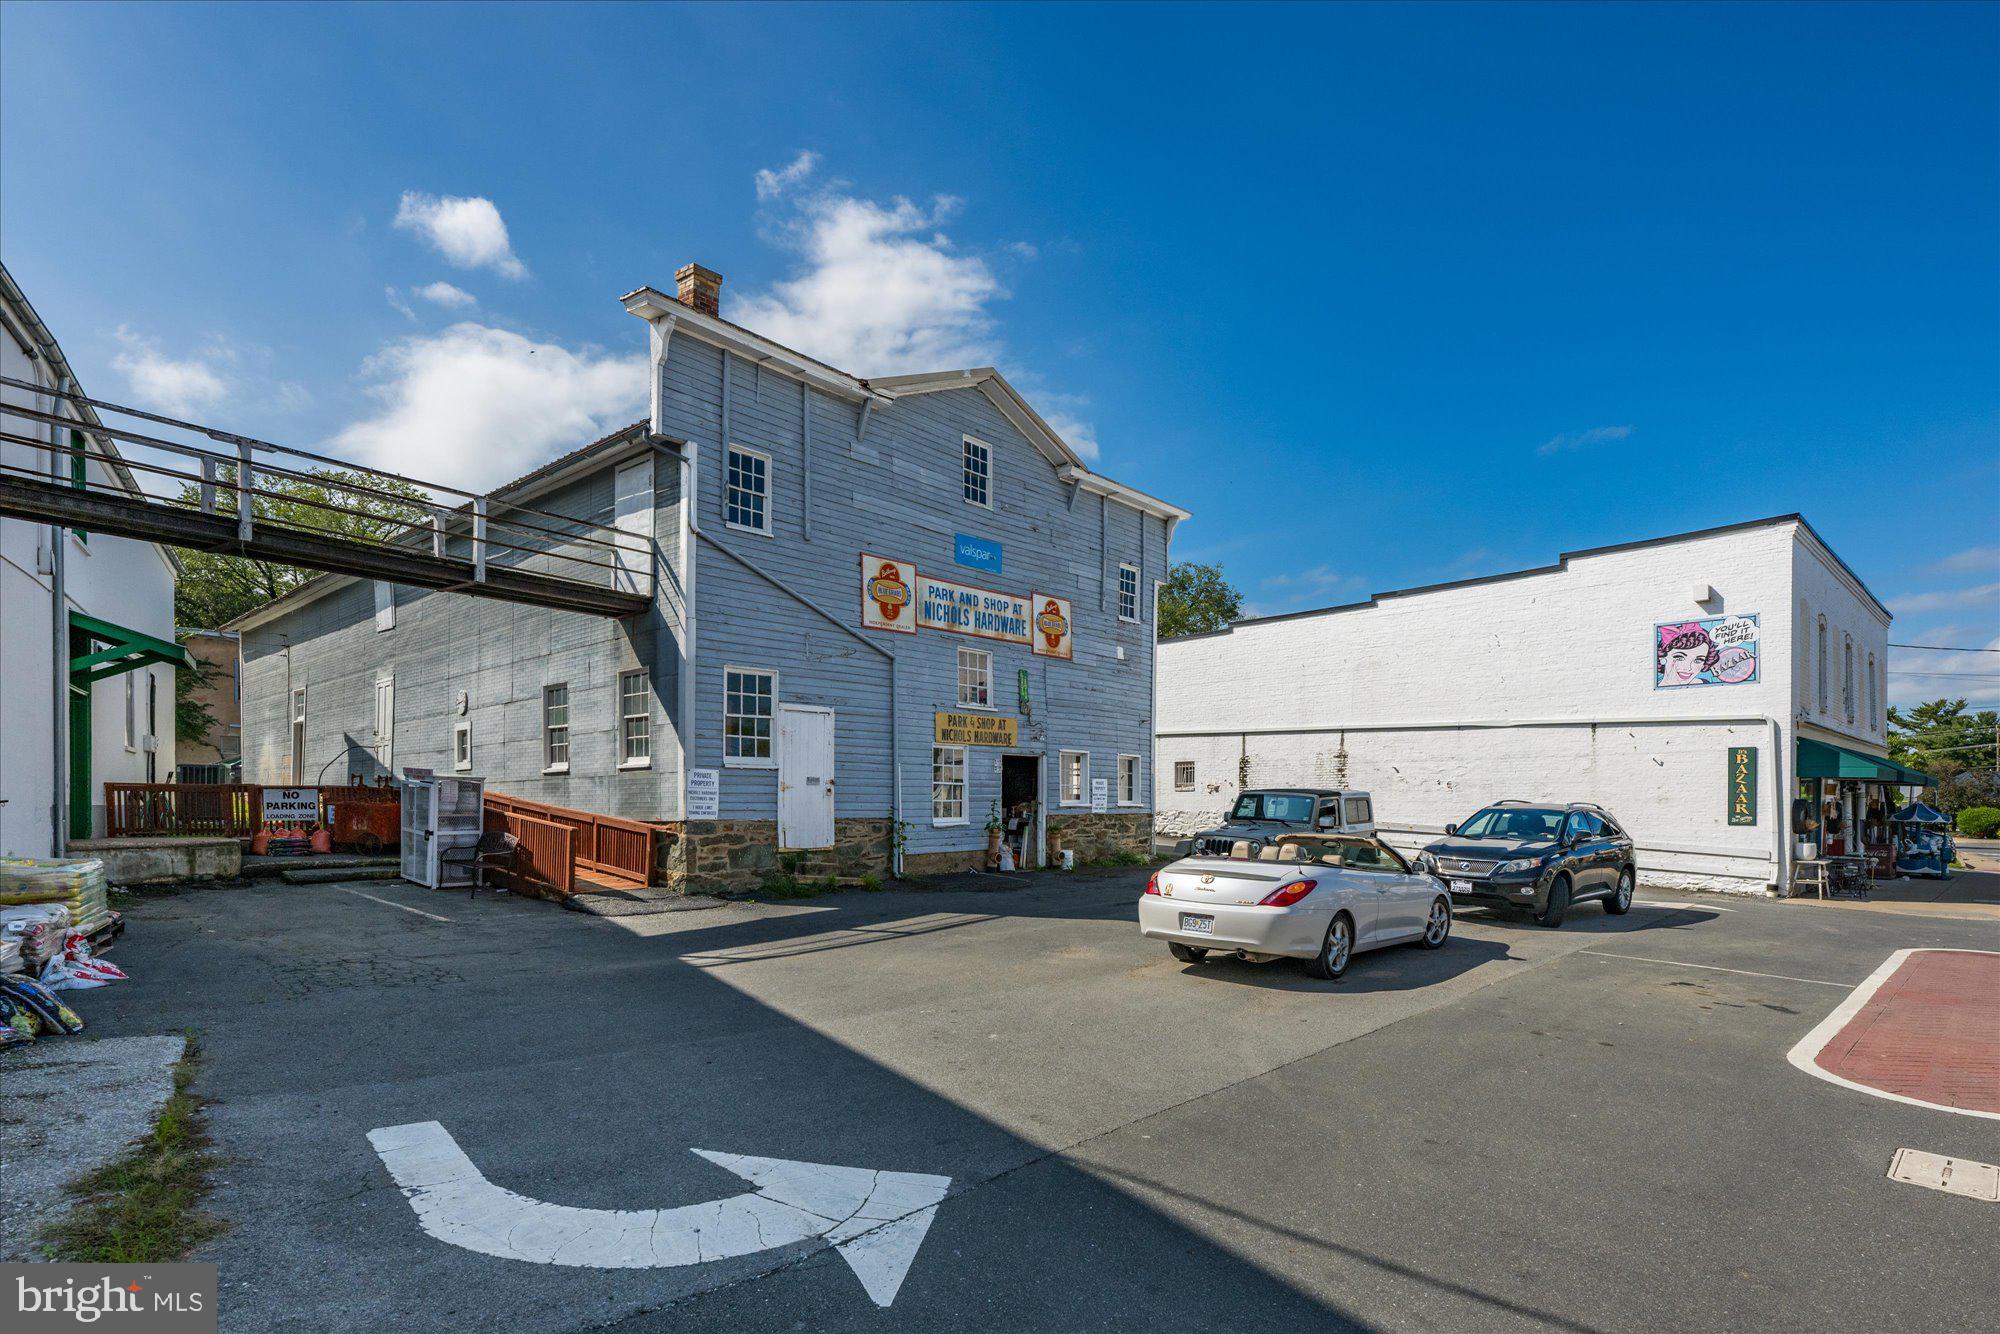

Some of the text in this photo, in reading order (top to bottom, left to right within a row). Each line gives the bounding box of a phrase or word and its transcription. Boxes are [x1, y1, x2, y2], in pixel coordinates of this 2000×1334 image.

[960, 544, 991, 561] valspar
[928, 585, 1023, 615] PARK AND SHOP AT
[924, 600, 1027, 636] NICHOLS HARDWARE
[1715, 621, 1749, 633] YOU'LL
[1715, 626, 1750, 639] FIND IT
[1723, 632, 1754, 644] HERE!
[1710, 651, 1755, 677] BAZAAR
[947, 714, 1007, 731] PARK & SHOP AT
[941, 728, 1012, 745] NICHOLS HARDWARE
[1735, 754, 1749, 815] BAZAAR
[282, 791, 300, 800] NO
[266, 802, 316, 810] PARKING
